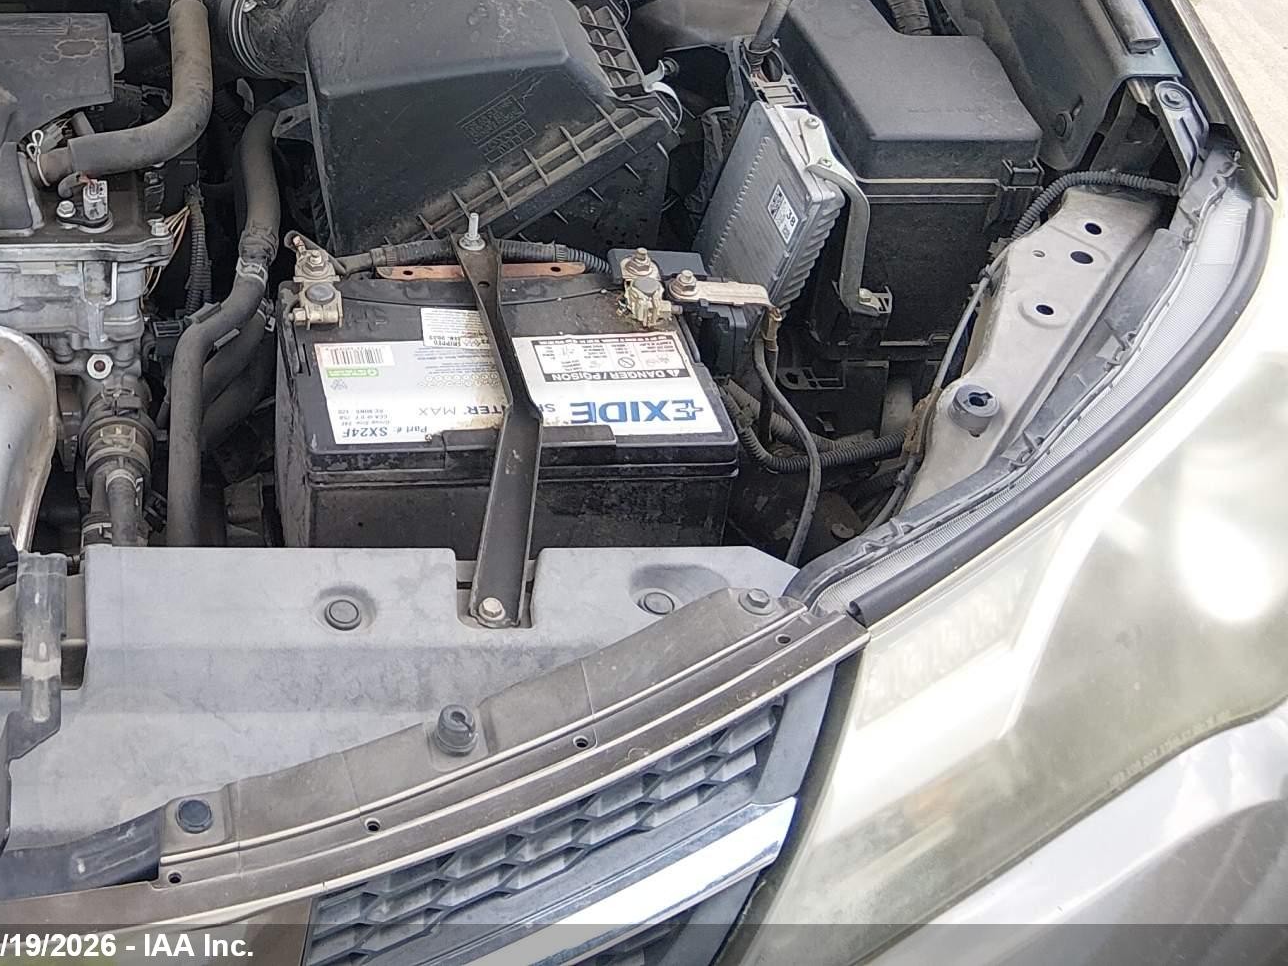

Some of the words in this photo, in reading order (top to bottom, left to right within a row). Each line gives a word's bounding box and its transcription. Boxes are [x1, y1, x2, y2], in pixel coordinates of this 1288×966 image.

[551, 371, 601, 381] POISON
[609, 370, 666, 380] DANGER
[418, 406, 456, 416] MAX
[570, 400, 704, 425] EXIDE
[342, 427, 388, 439] SX24F
[406, 426, 427, 434] Part
